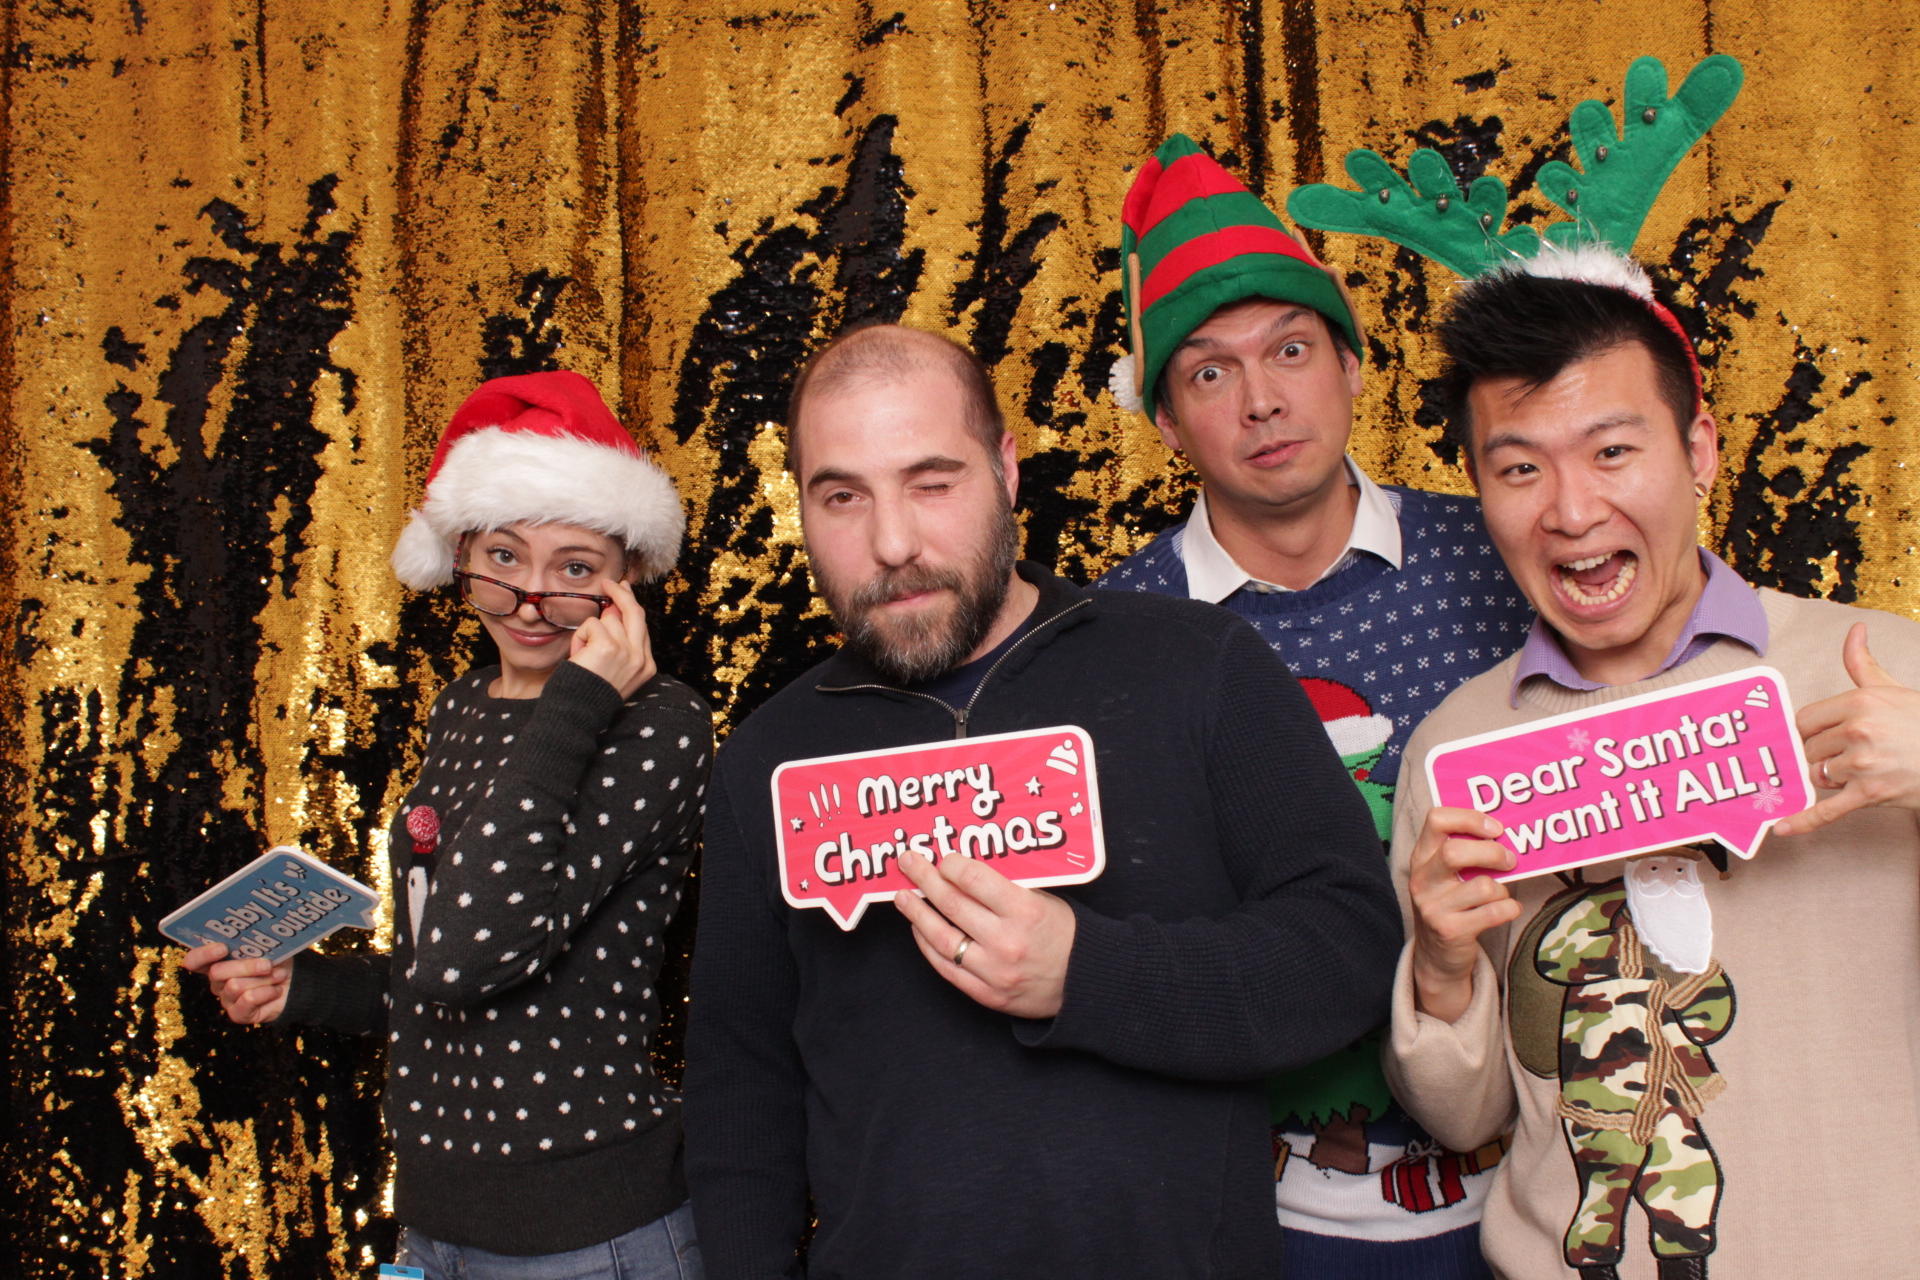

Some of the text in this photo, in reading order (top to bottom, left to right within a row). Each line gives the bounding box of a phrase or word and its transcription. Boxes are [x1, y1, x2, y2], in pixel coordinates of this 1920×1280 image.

[857, 763, 1002, 818] Merry
[1467, 709, 1748, 813] Dear Santa:
[814, 811, 1064, 884] Christmas
[1504, 790, 1622, 854] want
[1626, 778, 1664, 822] it
[204, 901, 276, 939] Baby
[270, 888, 351, 938] outside
